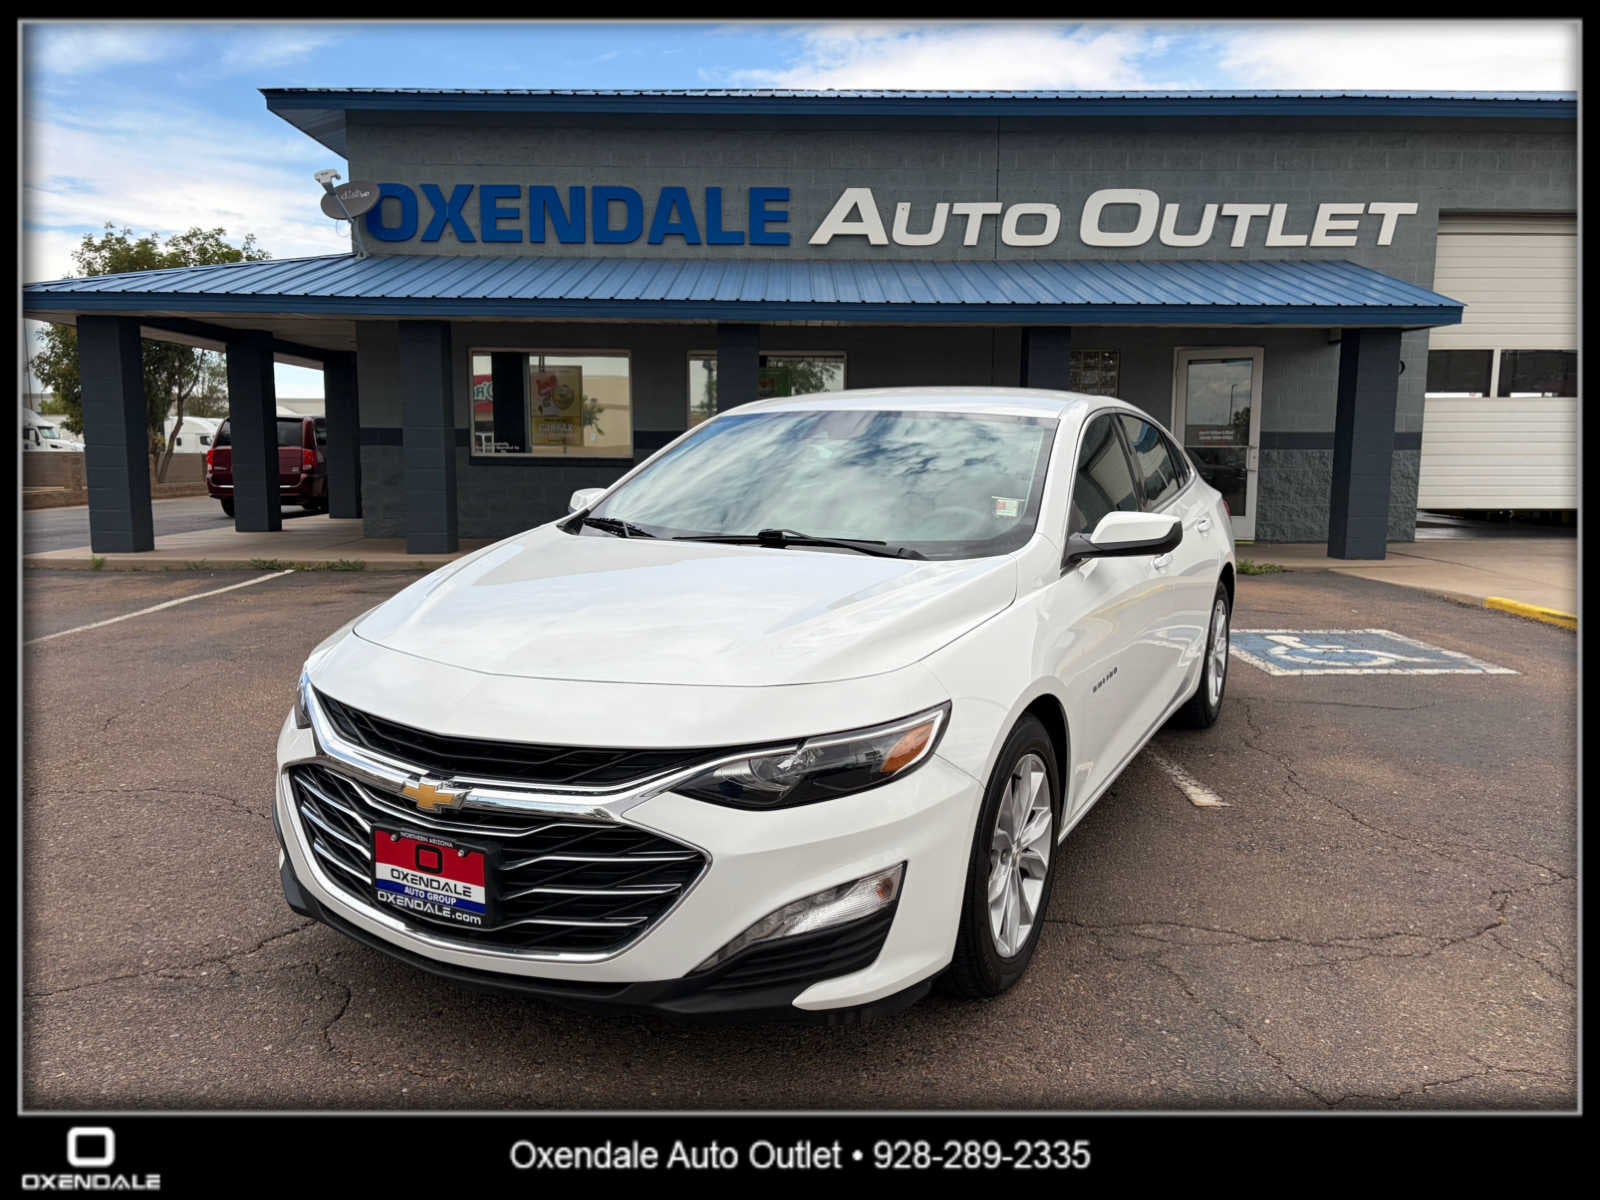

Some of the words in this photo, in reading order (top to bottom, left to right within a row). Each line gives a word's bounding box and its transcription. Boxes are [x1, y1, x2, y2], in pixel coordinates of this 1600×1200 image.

[366, 183, 790, 246] OXENDALE
[809, 187, 1061, 247] AUTO
[1079, 188, 1418, 248] OUTLET
[400, 831, 428, 843] NORTHERN
[429, 837, 454, 848] ARIZONA
[390, 868, 472, 898] OXENDALE
[404, 886, 425, 898] AUTO
[427, 892, 457, 906] GROUP
[377, 890, 482, 926] OXENDALE.com
